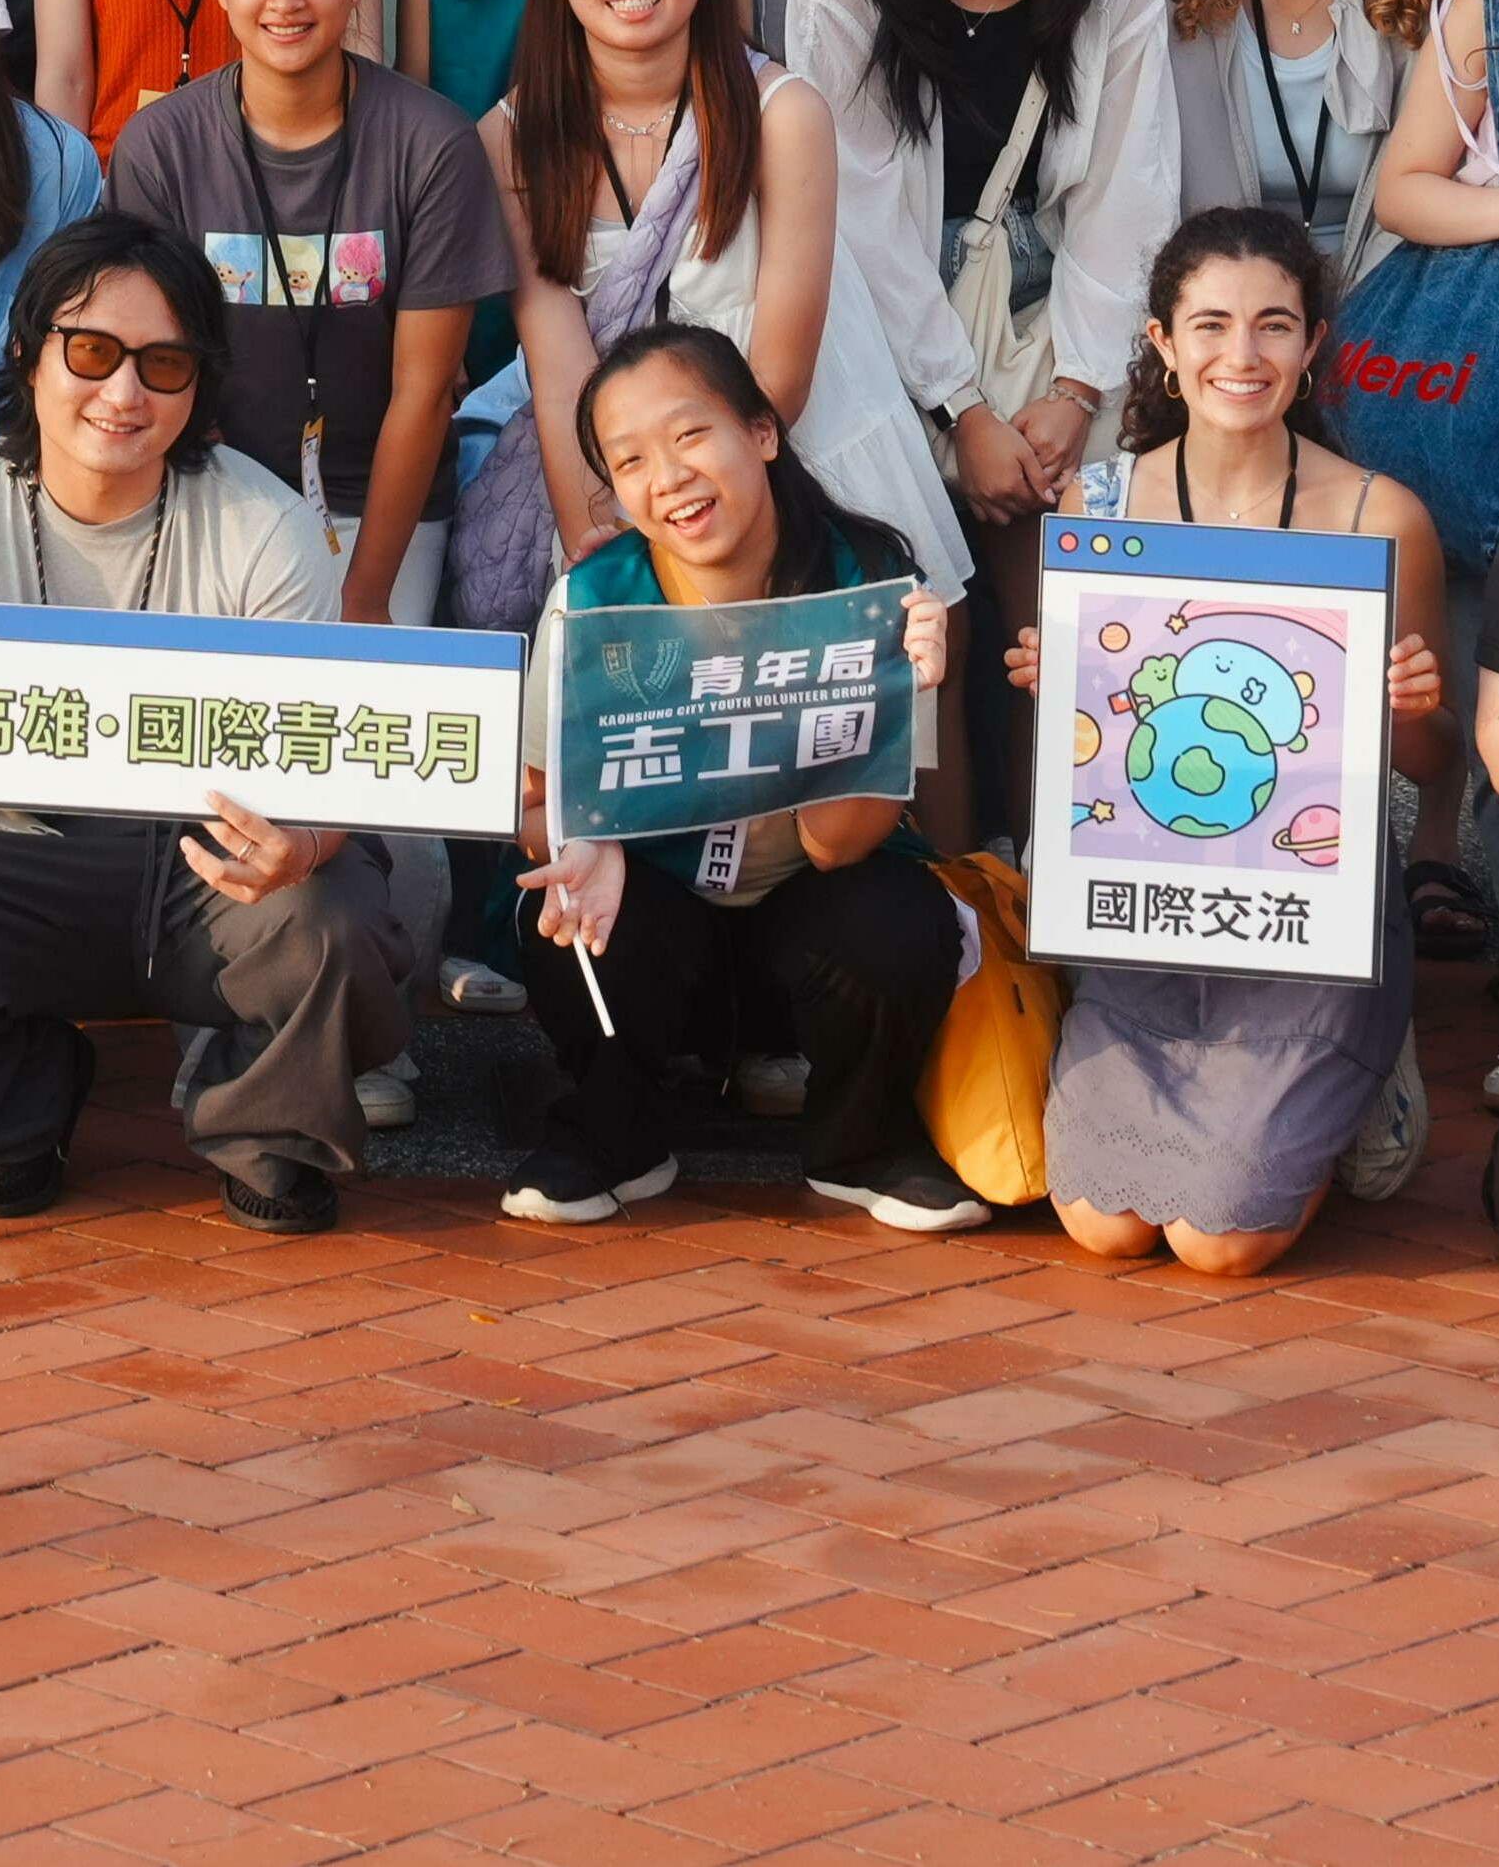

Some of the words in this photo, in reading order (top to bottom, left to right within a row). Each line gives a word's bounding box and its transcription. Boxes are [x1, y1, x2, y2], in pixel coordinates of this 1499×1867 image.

[1330, 338, 1479, 405] Merci
[690, 639, 877, 701] 青年局
[598, 707, 674, 727] KAOHSIUNG
[676, 702, 706, 717] CITY
[709, 697, 752, 713] YOUTH
[754, 689, 829, 709] VOLUNTEER
[831, 683, 877, 700] GROUP
[598, 701, 877, 791] 志工團
[1086, 878, 1311, 945] 國際交流
